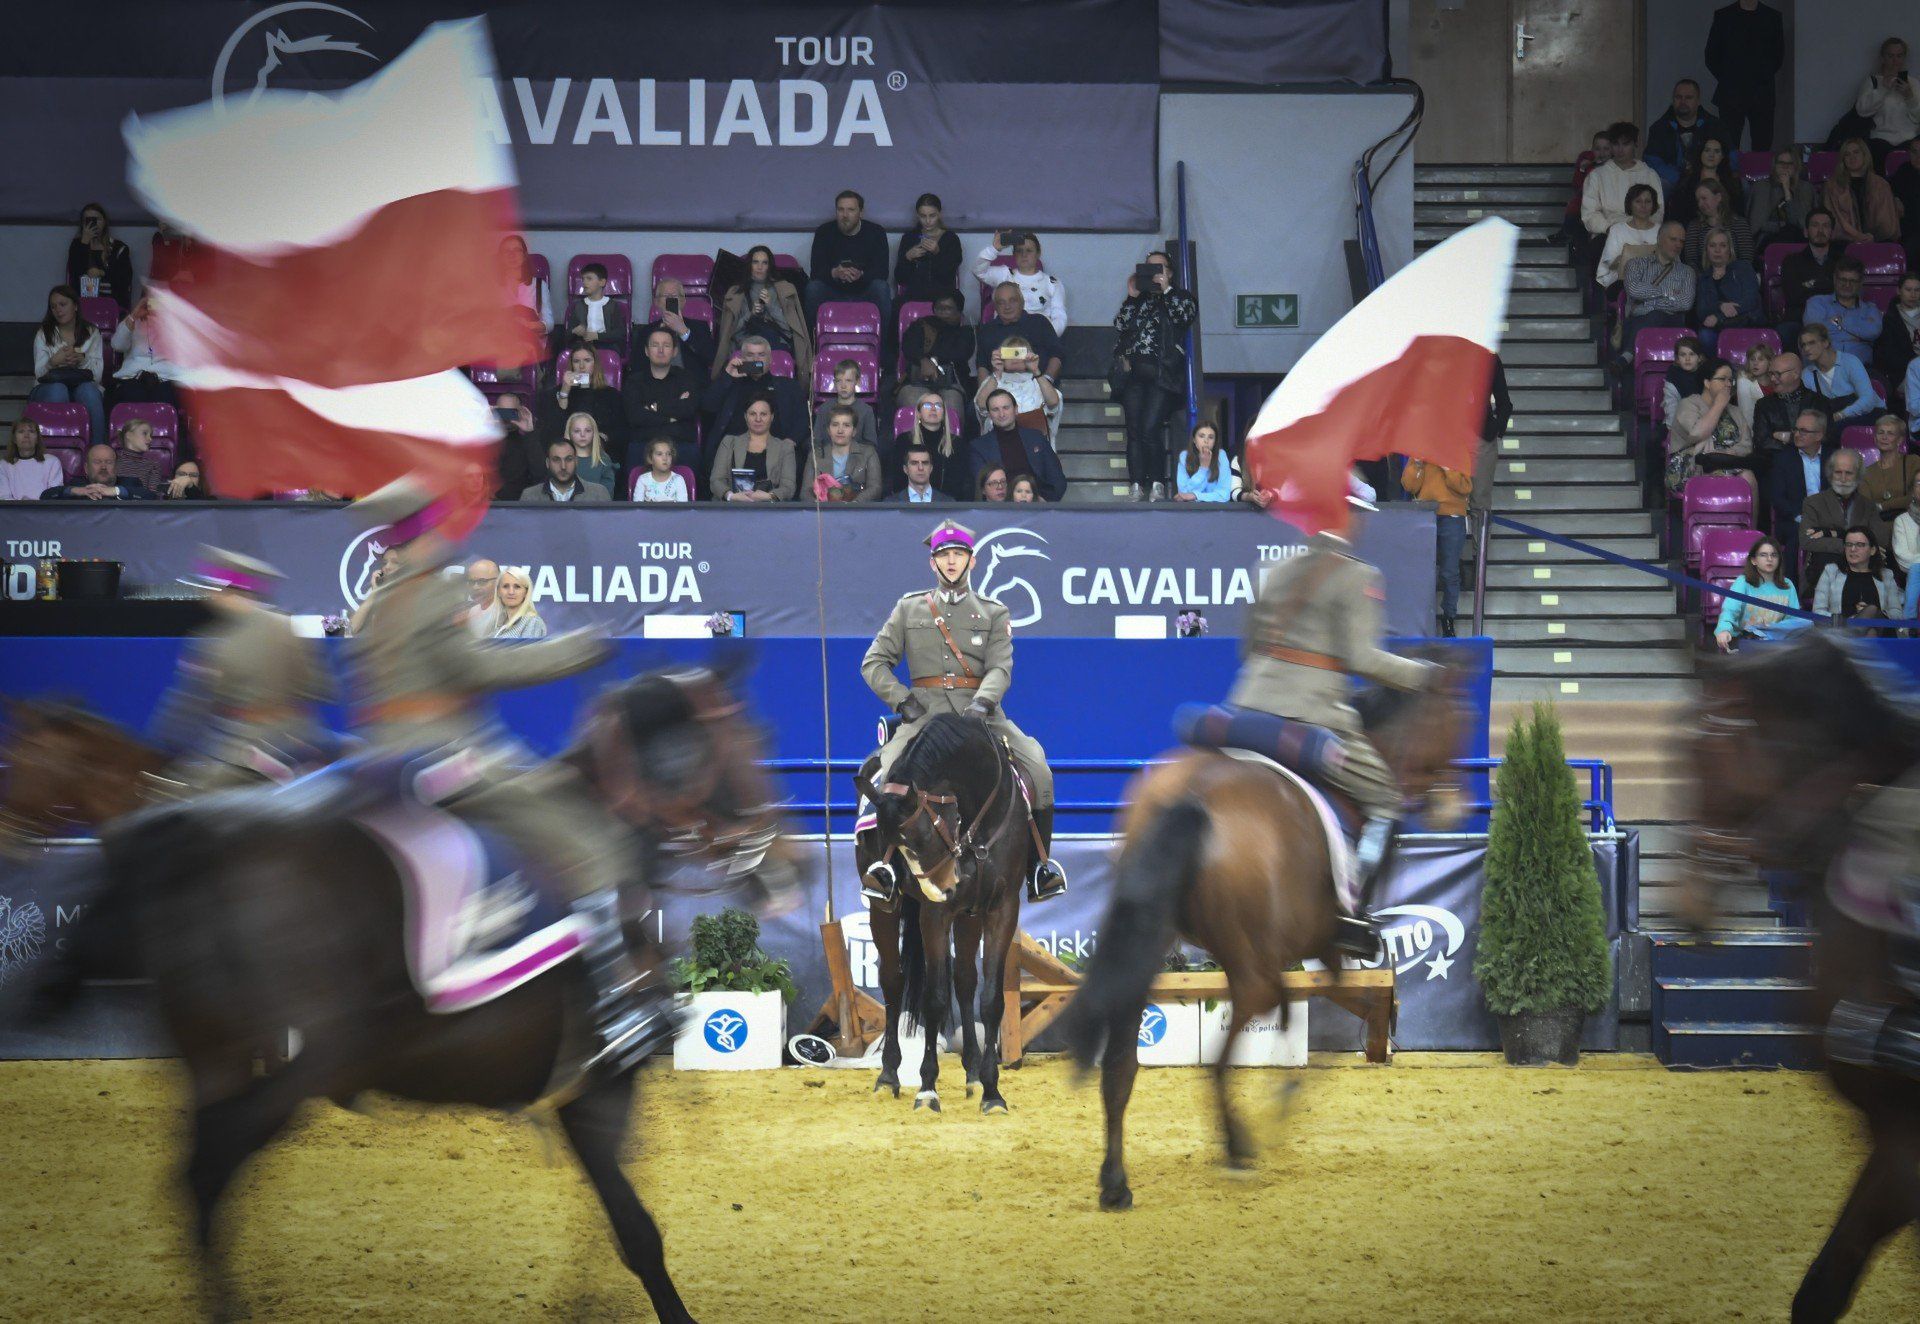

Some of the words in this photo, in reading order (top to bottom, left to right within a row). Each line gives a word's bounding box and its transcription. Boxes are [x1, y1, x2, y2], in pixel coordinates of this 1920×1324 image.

[775, 36, 874, 66] TOUR
[6, 540, 62, 558] TOUR
[638, 542, 693, 560] TOUR
[1061, 566, 1274, 605] CAVALIA
